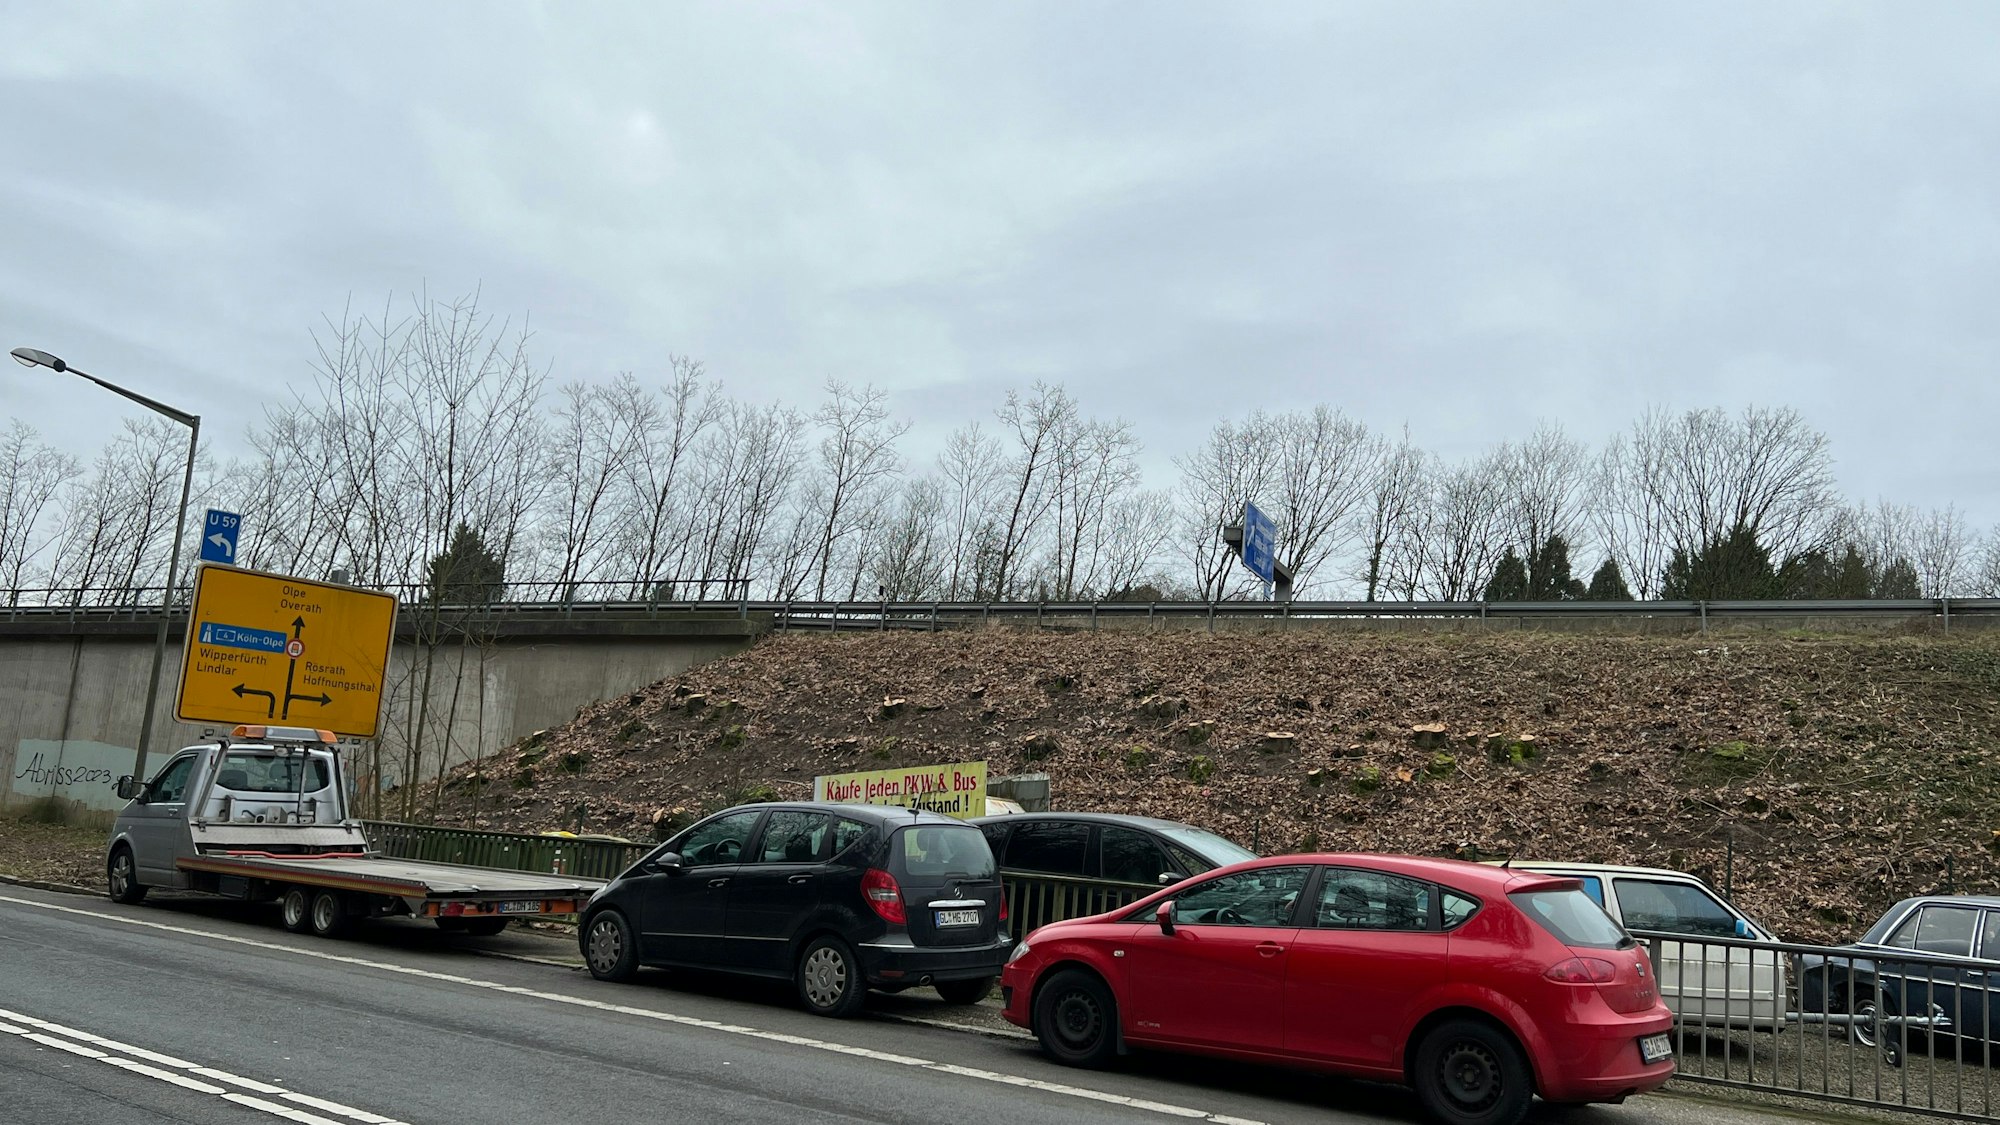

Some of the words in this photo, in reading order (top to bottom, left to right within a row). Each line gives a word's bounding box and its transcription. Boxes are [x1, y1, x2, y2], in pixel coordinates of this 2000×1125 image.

[209, 513, 219, 526] U
[221, 515, 238, 529] 59
[281, 585, 307, 598] Olpe
[280, 599, 322, 614] Overath
[236, 632, 284, 648] Köln-Olpe
[200, 648, 267, 665] Wipperfürth
[196, 661, 238, 676] Lindlar
[305, 661, 346, 676] Rösrath
[303, 674, 376, 693] Hoffnungsthal
[826, 779, 861, 801] Kaufe
[864, 777, 899, 803] Jeden
[903, 773, 934, 796] PKW
[937, 772, 949, 790] &
[953, 771, 977, 792] Bus
